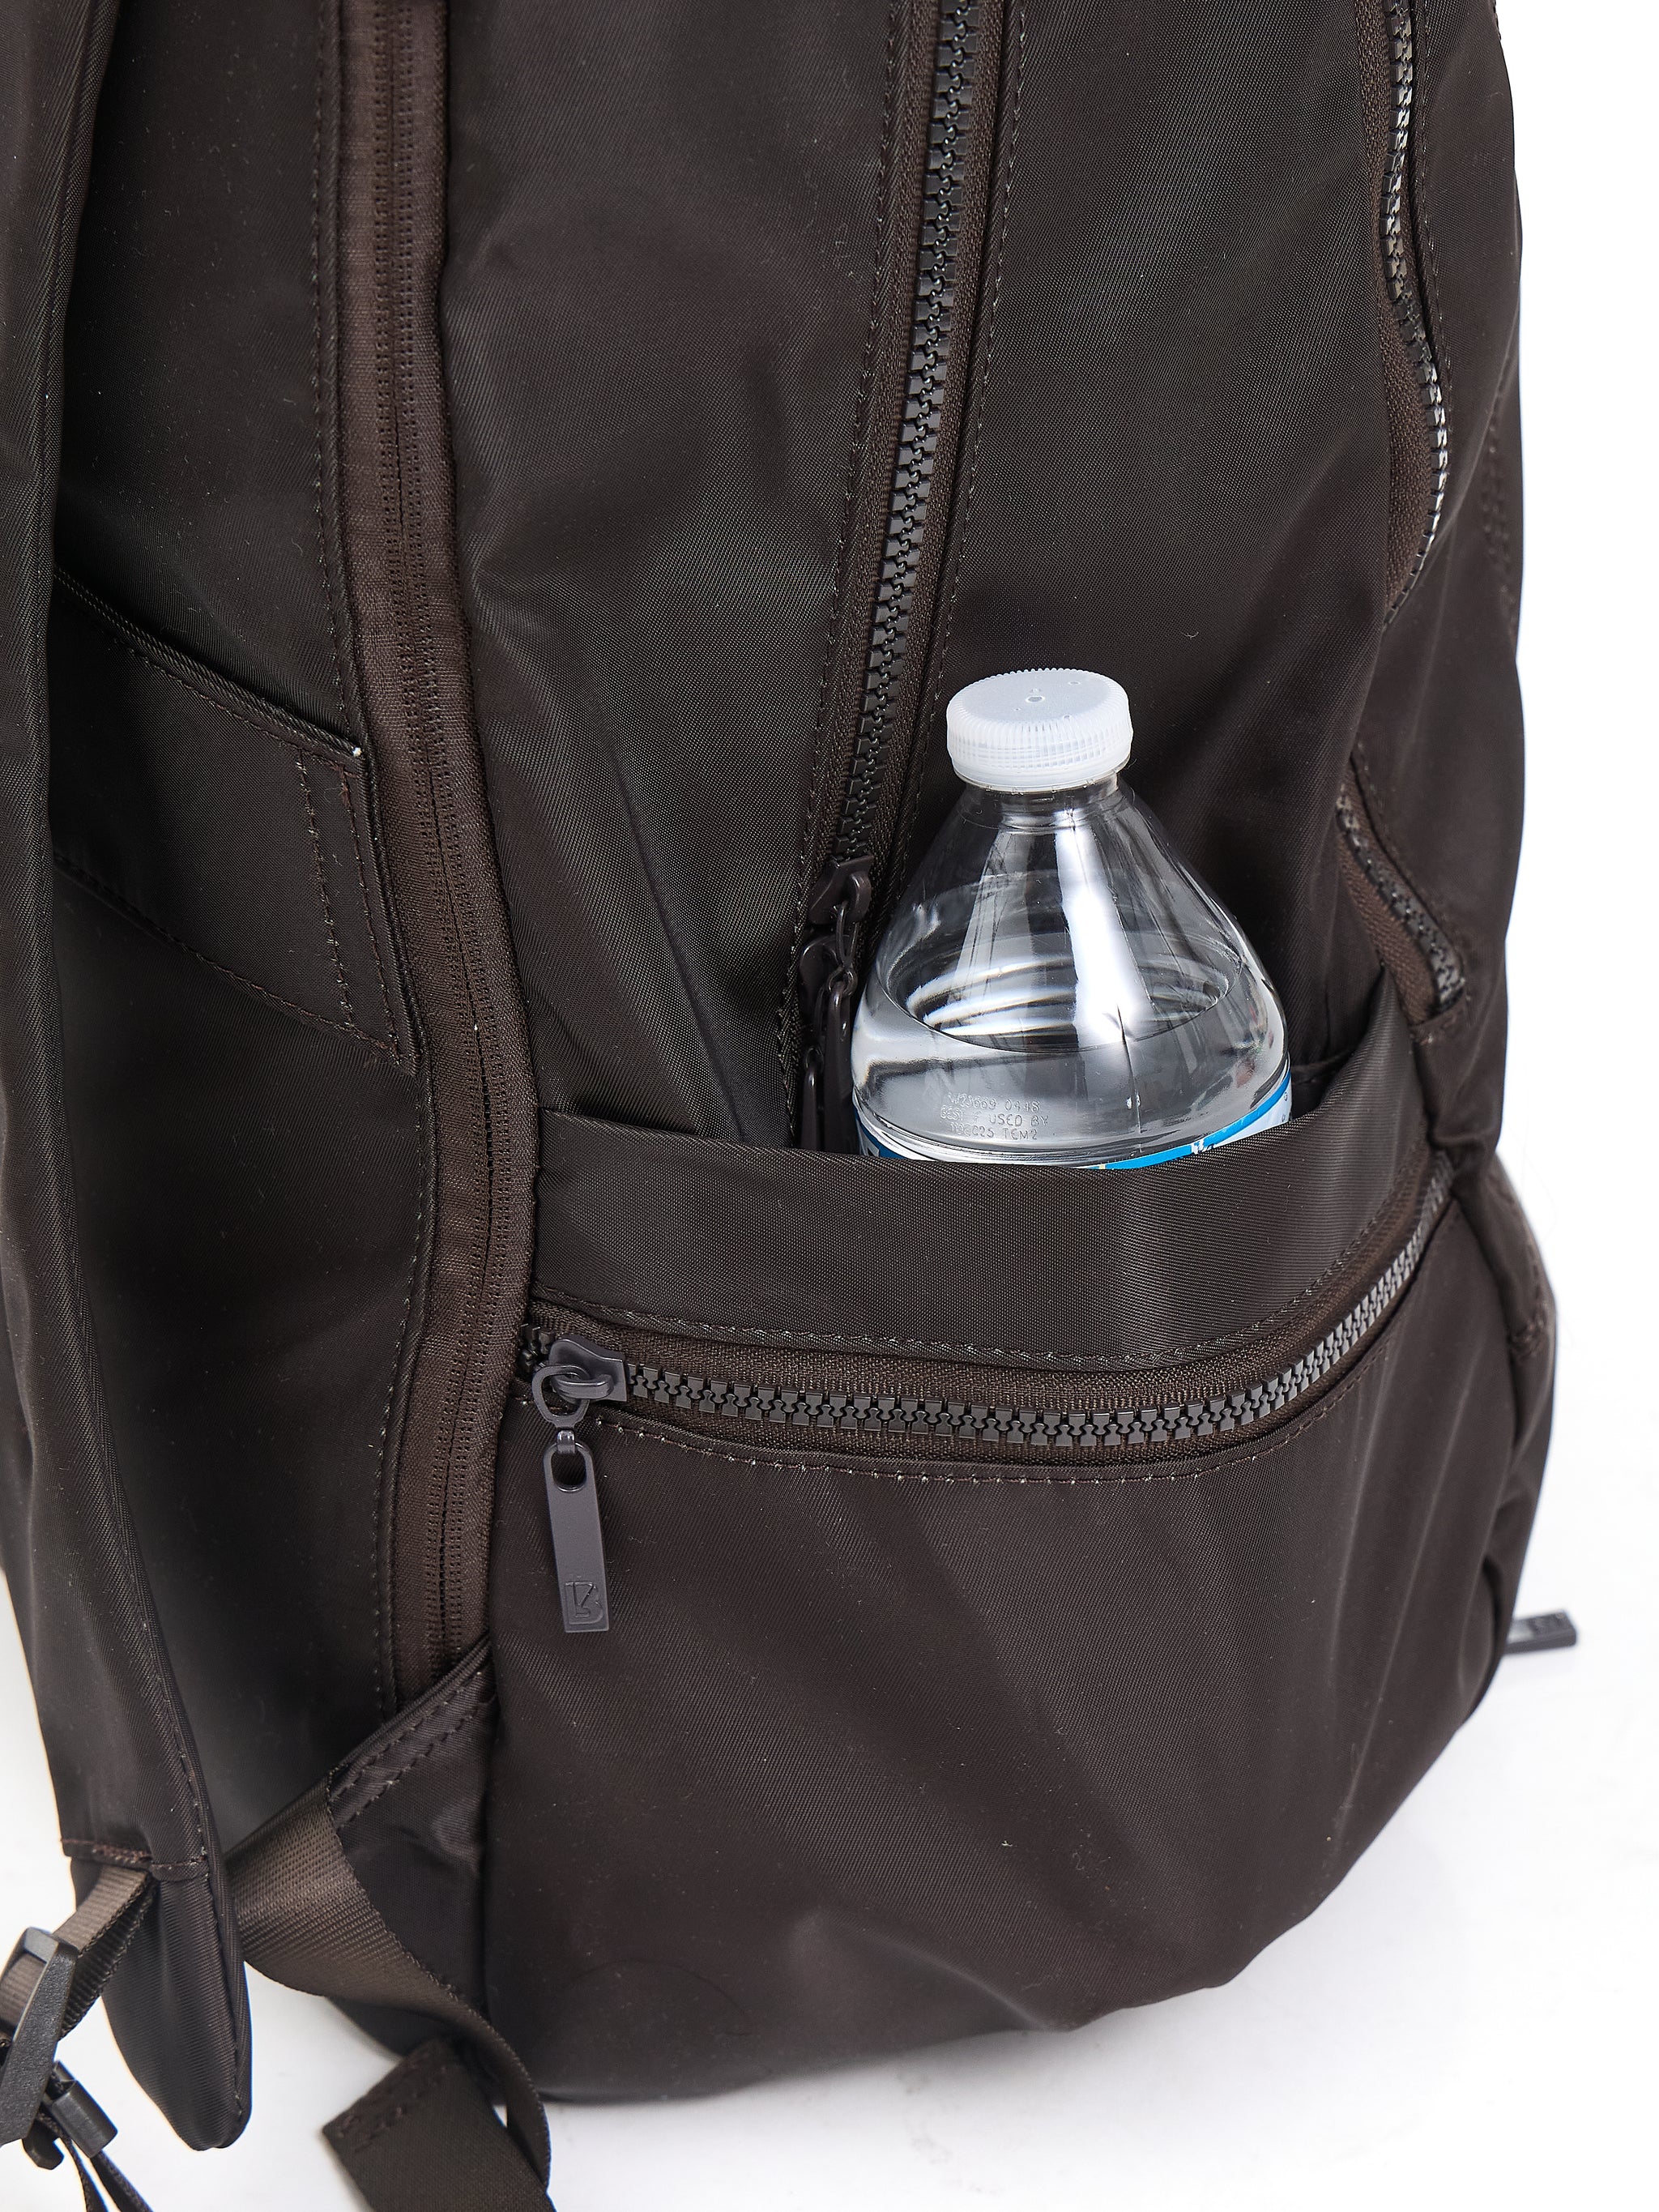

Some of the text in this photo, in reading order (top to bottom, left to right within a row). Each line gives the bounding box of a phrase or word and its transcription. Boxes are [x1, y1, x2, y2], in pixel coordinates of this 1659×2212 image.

[940, 1105, 963, 1121] BEST
[989, 1112, 1023, 1127] USED
[1030, 1115, 1049, 1126] BY
